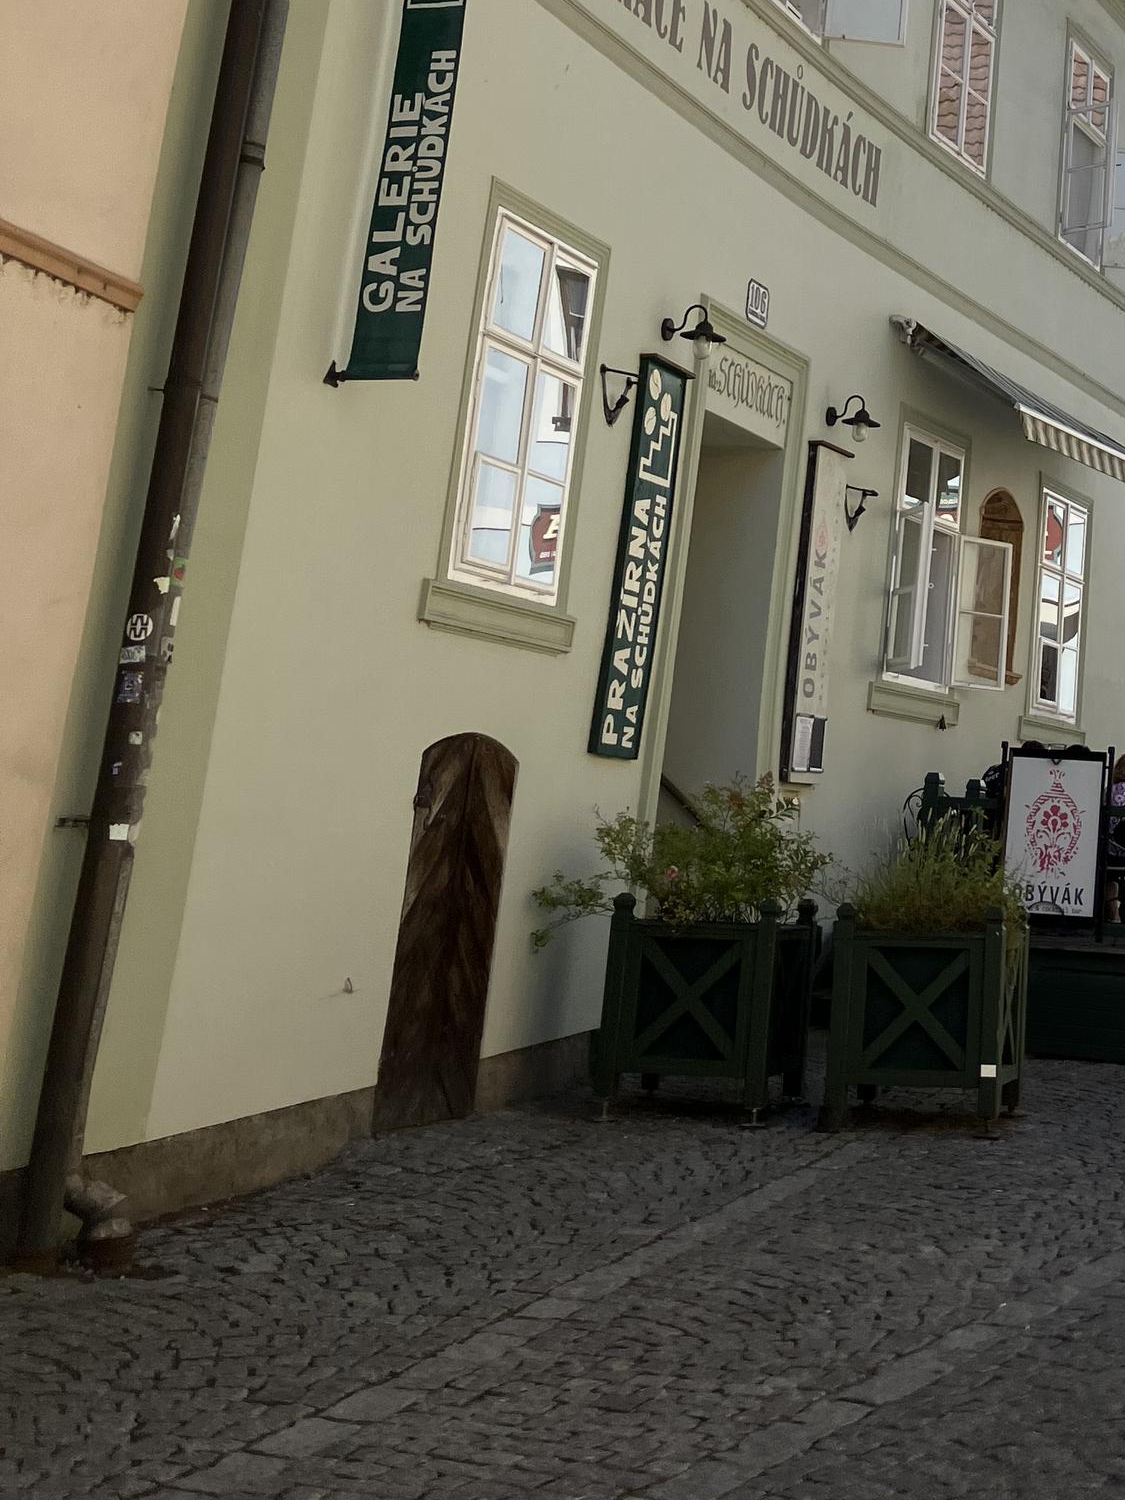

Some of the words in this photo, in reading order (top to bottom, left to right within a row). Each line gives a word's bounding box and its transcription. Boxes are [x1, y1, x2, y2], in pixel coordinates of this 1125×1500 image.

[363, 93, 424, 312] GALERIE
[406, 49, 457, 245] SCHŮDKÁCH
[696, 0, 732, 95] NA
[742, 43, 882, 207] SCHŮDKÁCH
[395, 266, 426, 312] NA
[750, 284, 767, 314] 106
[600, 497, 651, 746] PRAŽÍRNA
[621, 703, 638, 749] NA
[630, 494, 668, 688] SCHŮDKÁCH
[803, 549, 828, 698] OBÝVÁK
